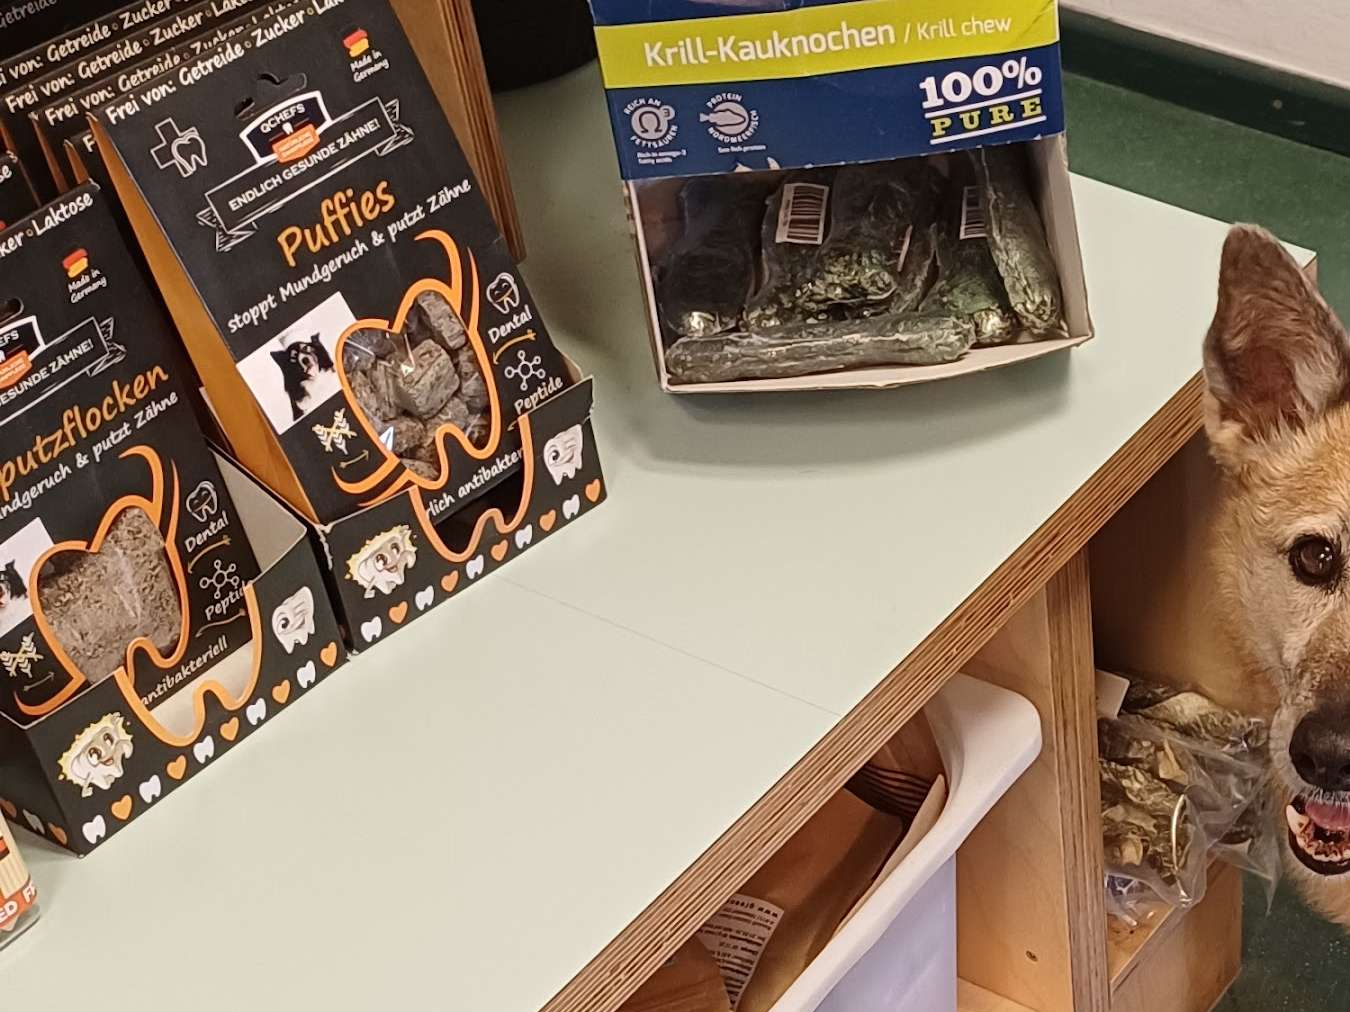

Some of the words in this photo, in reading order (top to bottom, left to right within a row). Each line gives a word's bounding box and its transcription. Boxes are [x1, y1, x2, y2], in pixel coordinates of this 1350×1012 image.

[5, 85, 40, 114] Frei
[40, 73, 76, 97] von:
[78, 40, 143, 79] Getreide
[150, 12, 203, 46] Zucker
[9, 55, 44, 80] von:
[47, 22, 112, 63] Getreide
[105, 94, 140, 125] Frei
[140, 80, 177, 106] von:
[178, 41, 245, 86] Getreide
[250, 10, 305, 47] Zucker
[643, 21, 896, 67] Krill-Kauknochen
[917, 18, 956, 41] Krill
[961, 16, 1012, 36] chew
[45, 97, 79, 126] Frei
[80, 87, 116, 110] von:
[706, 93, 743, 109] PROTEIN
[919, 56, 1042, 109] 100%
[260, 103, 306, 134] QCHEFS
[930, 96, 1042, 137] PURE
[228, 174, 284, 212] ENDLICH
[282, 142, 337, 181] GESUNDE
[336, 117, 381, 150] ZÄHNE!
[32, 193, 94, 236] Laktose
[276, 180, 396, 268] Puffies
[227, 294, 277, 334] stoppt
[279, 239, 369, 302] Mundgeruch
[371, 231, 386, 247] &
[387, 205, 426, 243] putzt
[425, 178, 473, 215] Zähne
[488, 304, 533, 344] Dental
[0, 366, 50, 408] ESUNDE
[49, 338, 94, 374] ZÄHNE!
[514, 376, 564, 414] Peptide
[75, 452, 90, 469] &
[92, 422, 132, 463] putzt
[134, 391, 178, 429] Zähne
[184, 510, 229, 553] Dental
